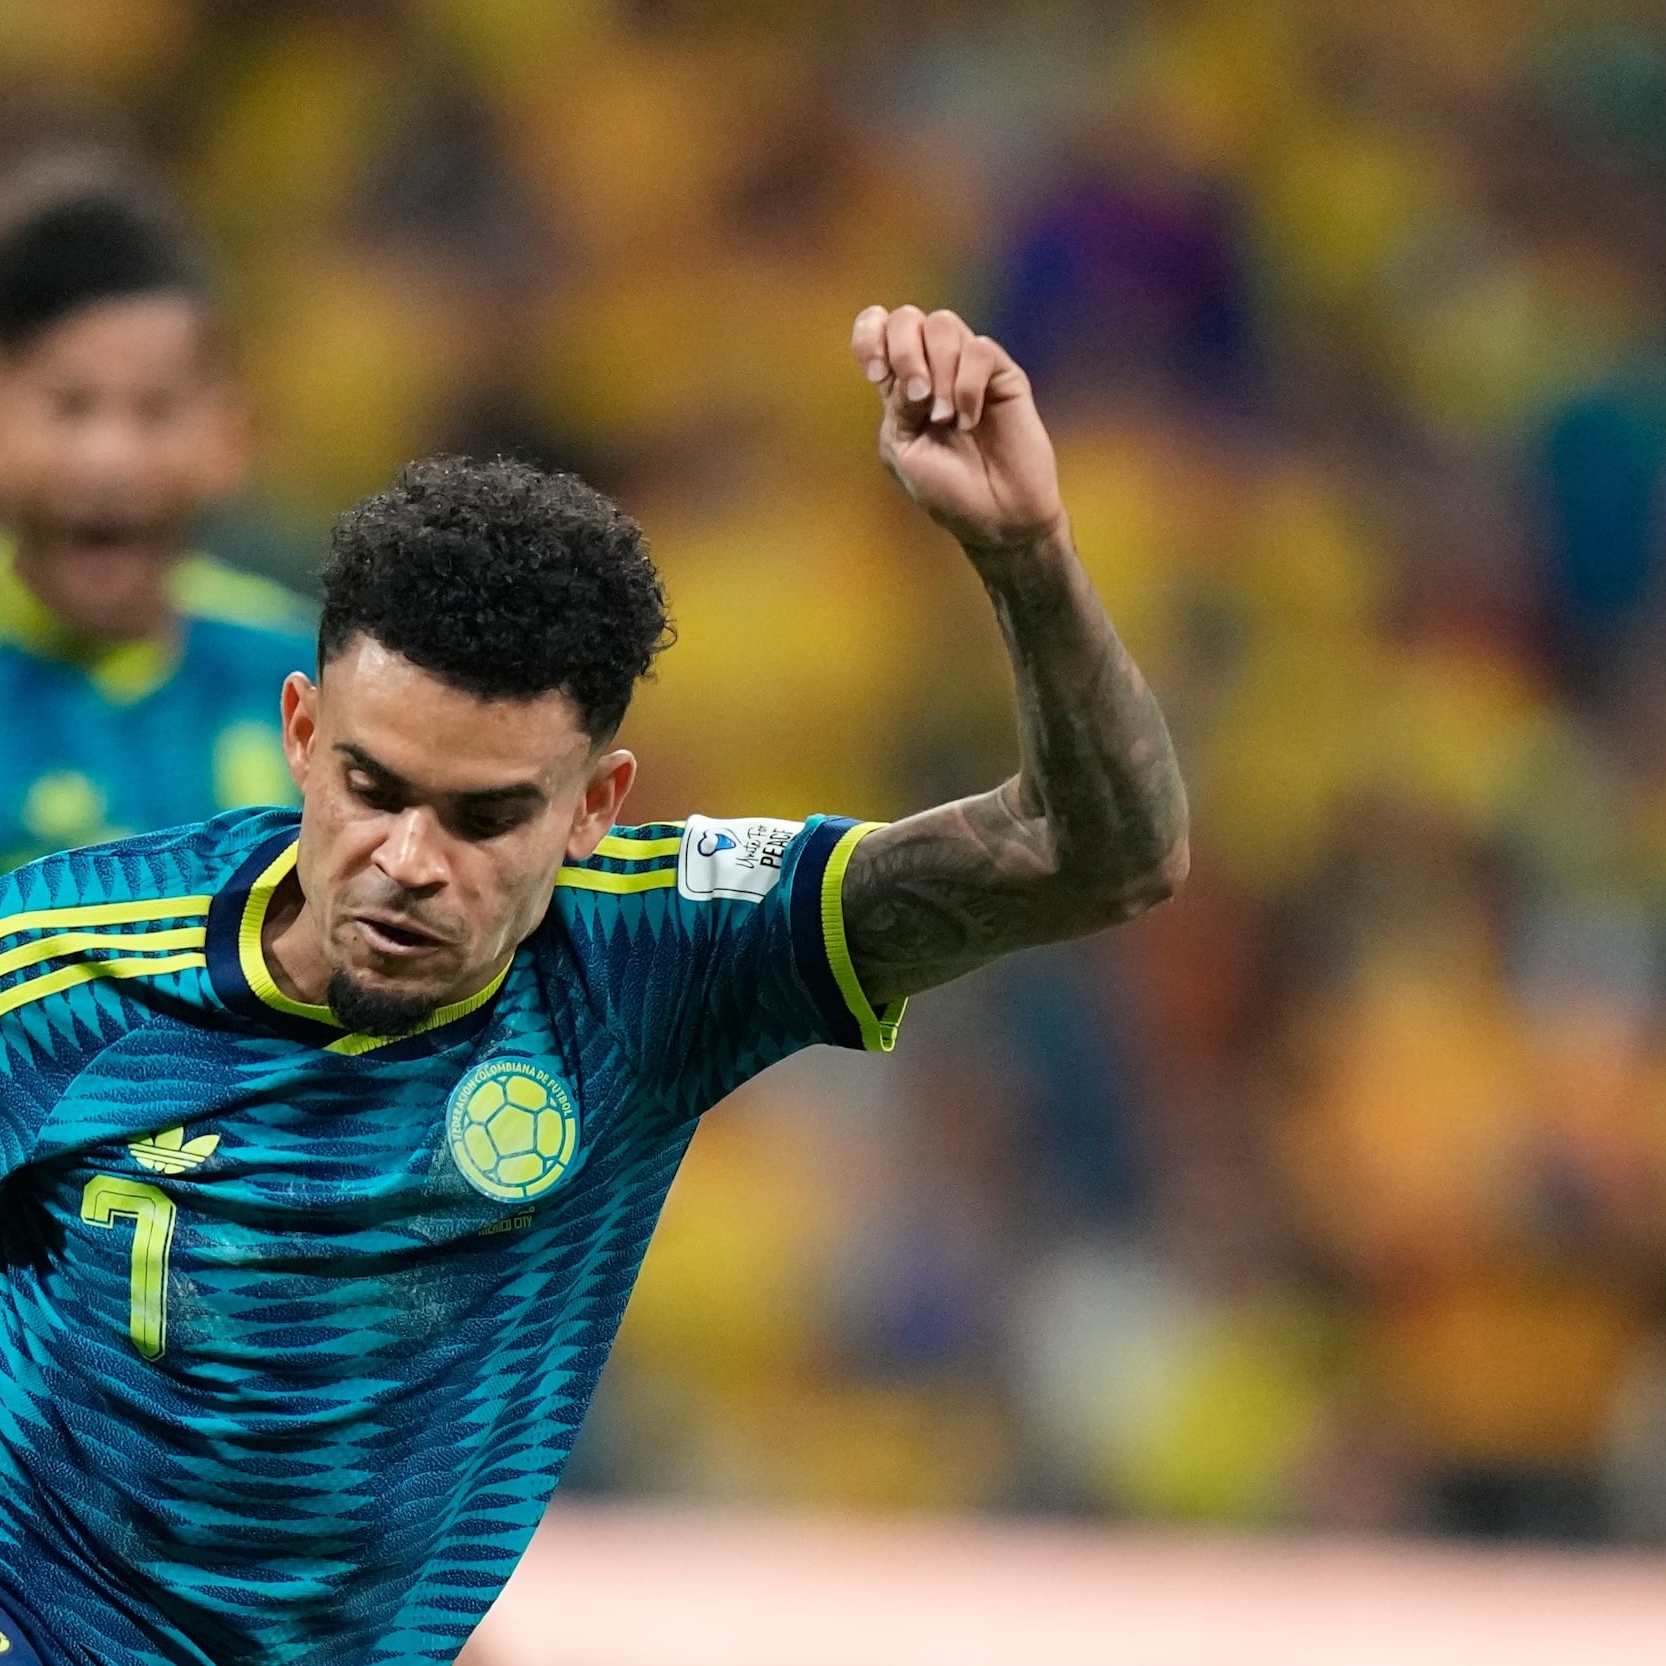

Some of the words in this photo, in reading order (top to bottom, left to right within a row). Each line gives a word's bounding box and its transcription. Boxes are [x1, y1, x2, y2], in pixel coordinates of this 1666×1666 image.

[475, 1062, 536, 1084] COLOMBIANA
[535, 1070, 550, 1084] DE
[514, 1215, 532, 1229] CITY
[80, 1174, 177, 1363] 7
